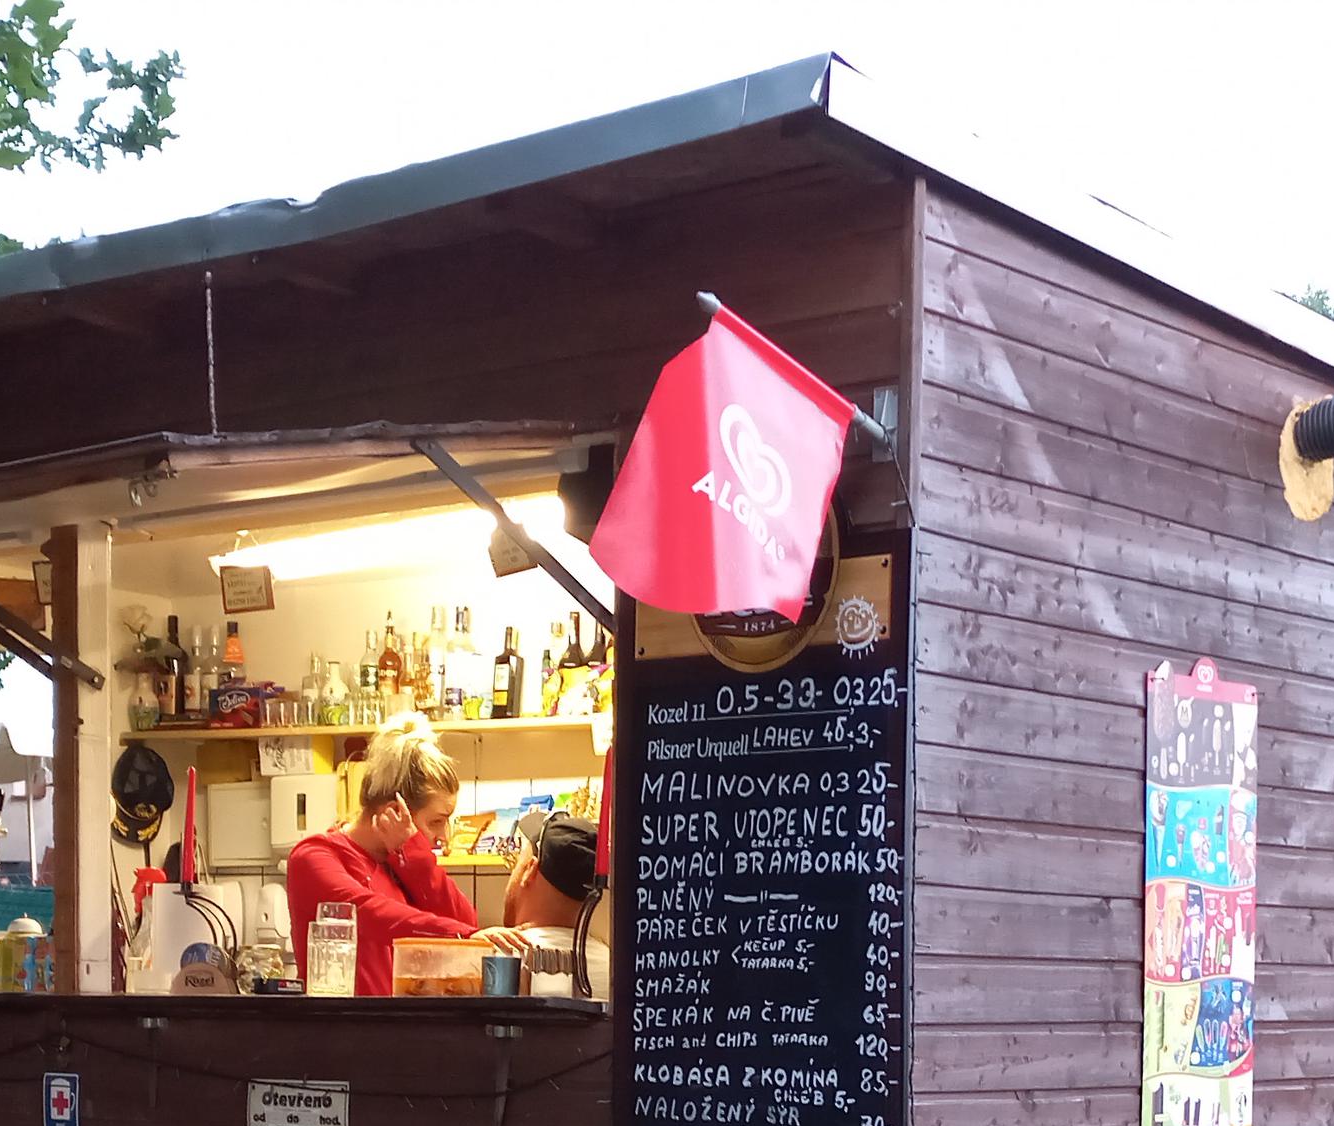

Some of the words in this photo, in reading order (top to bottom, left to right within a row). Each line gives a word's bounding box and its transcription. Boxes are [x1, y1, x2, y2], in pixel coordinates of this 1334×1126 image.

[691, 469, 779, 565] ALGIDA
[743, 619, 776, 633] 1874
[647, 701, 690, 725] Kozel
[692, 703, 706, 721] 11
[646, 742, 696, 761] Pilsner
[696, 733, 750, 763] Urquell
[753, 726, 814, 748] LAHEV
[640, 771, 810, 804] MALINOVKA
[640, 811, 719, 846] SUPER
[734, 804, 849, 840] UTOPENEC
[638, 840, 725, 881] DOMÁCÍ
[734, 841, 871, 876] BRAMBORÁK
[636, 880, 715, 913] PLNĚNÝ
[636, 911, 728, 945] PÁREČEK
[757, 904, 840, 934] TĚSTÍČKU
[744, 936, 786, 953] KEČUP
[634, 949, 720, 973] HRANOLKY
[741, 957, 794, 970] TATARKA
[634, 970, 711, 999] SMAŽÁK
[632, 998, 715, 1032] ŠPEKÁK
[727, 1004, 752, 1022] NA
[634, 1035, 675, 1053] FISCH
[682, 1032, 708, 1049] and
[715, 1031, 759, 1048] CHIPS
[771, 1032, 830, 1047] TATARKA
[634, 1058, 731, 1088] KLOBÁSA
[761, 1057, 839, 1088] KOMÍNA
[261, 1090, 334, 1109] Otevřeno
[634, 1095, 757, 1123] NALOŽENÝ
[252, 1112, 267, 1123] od
[286, 1114, 300, 1124] do
